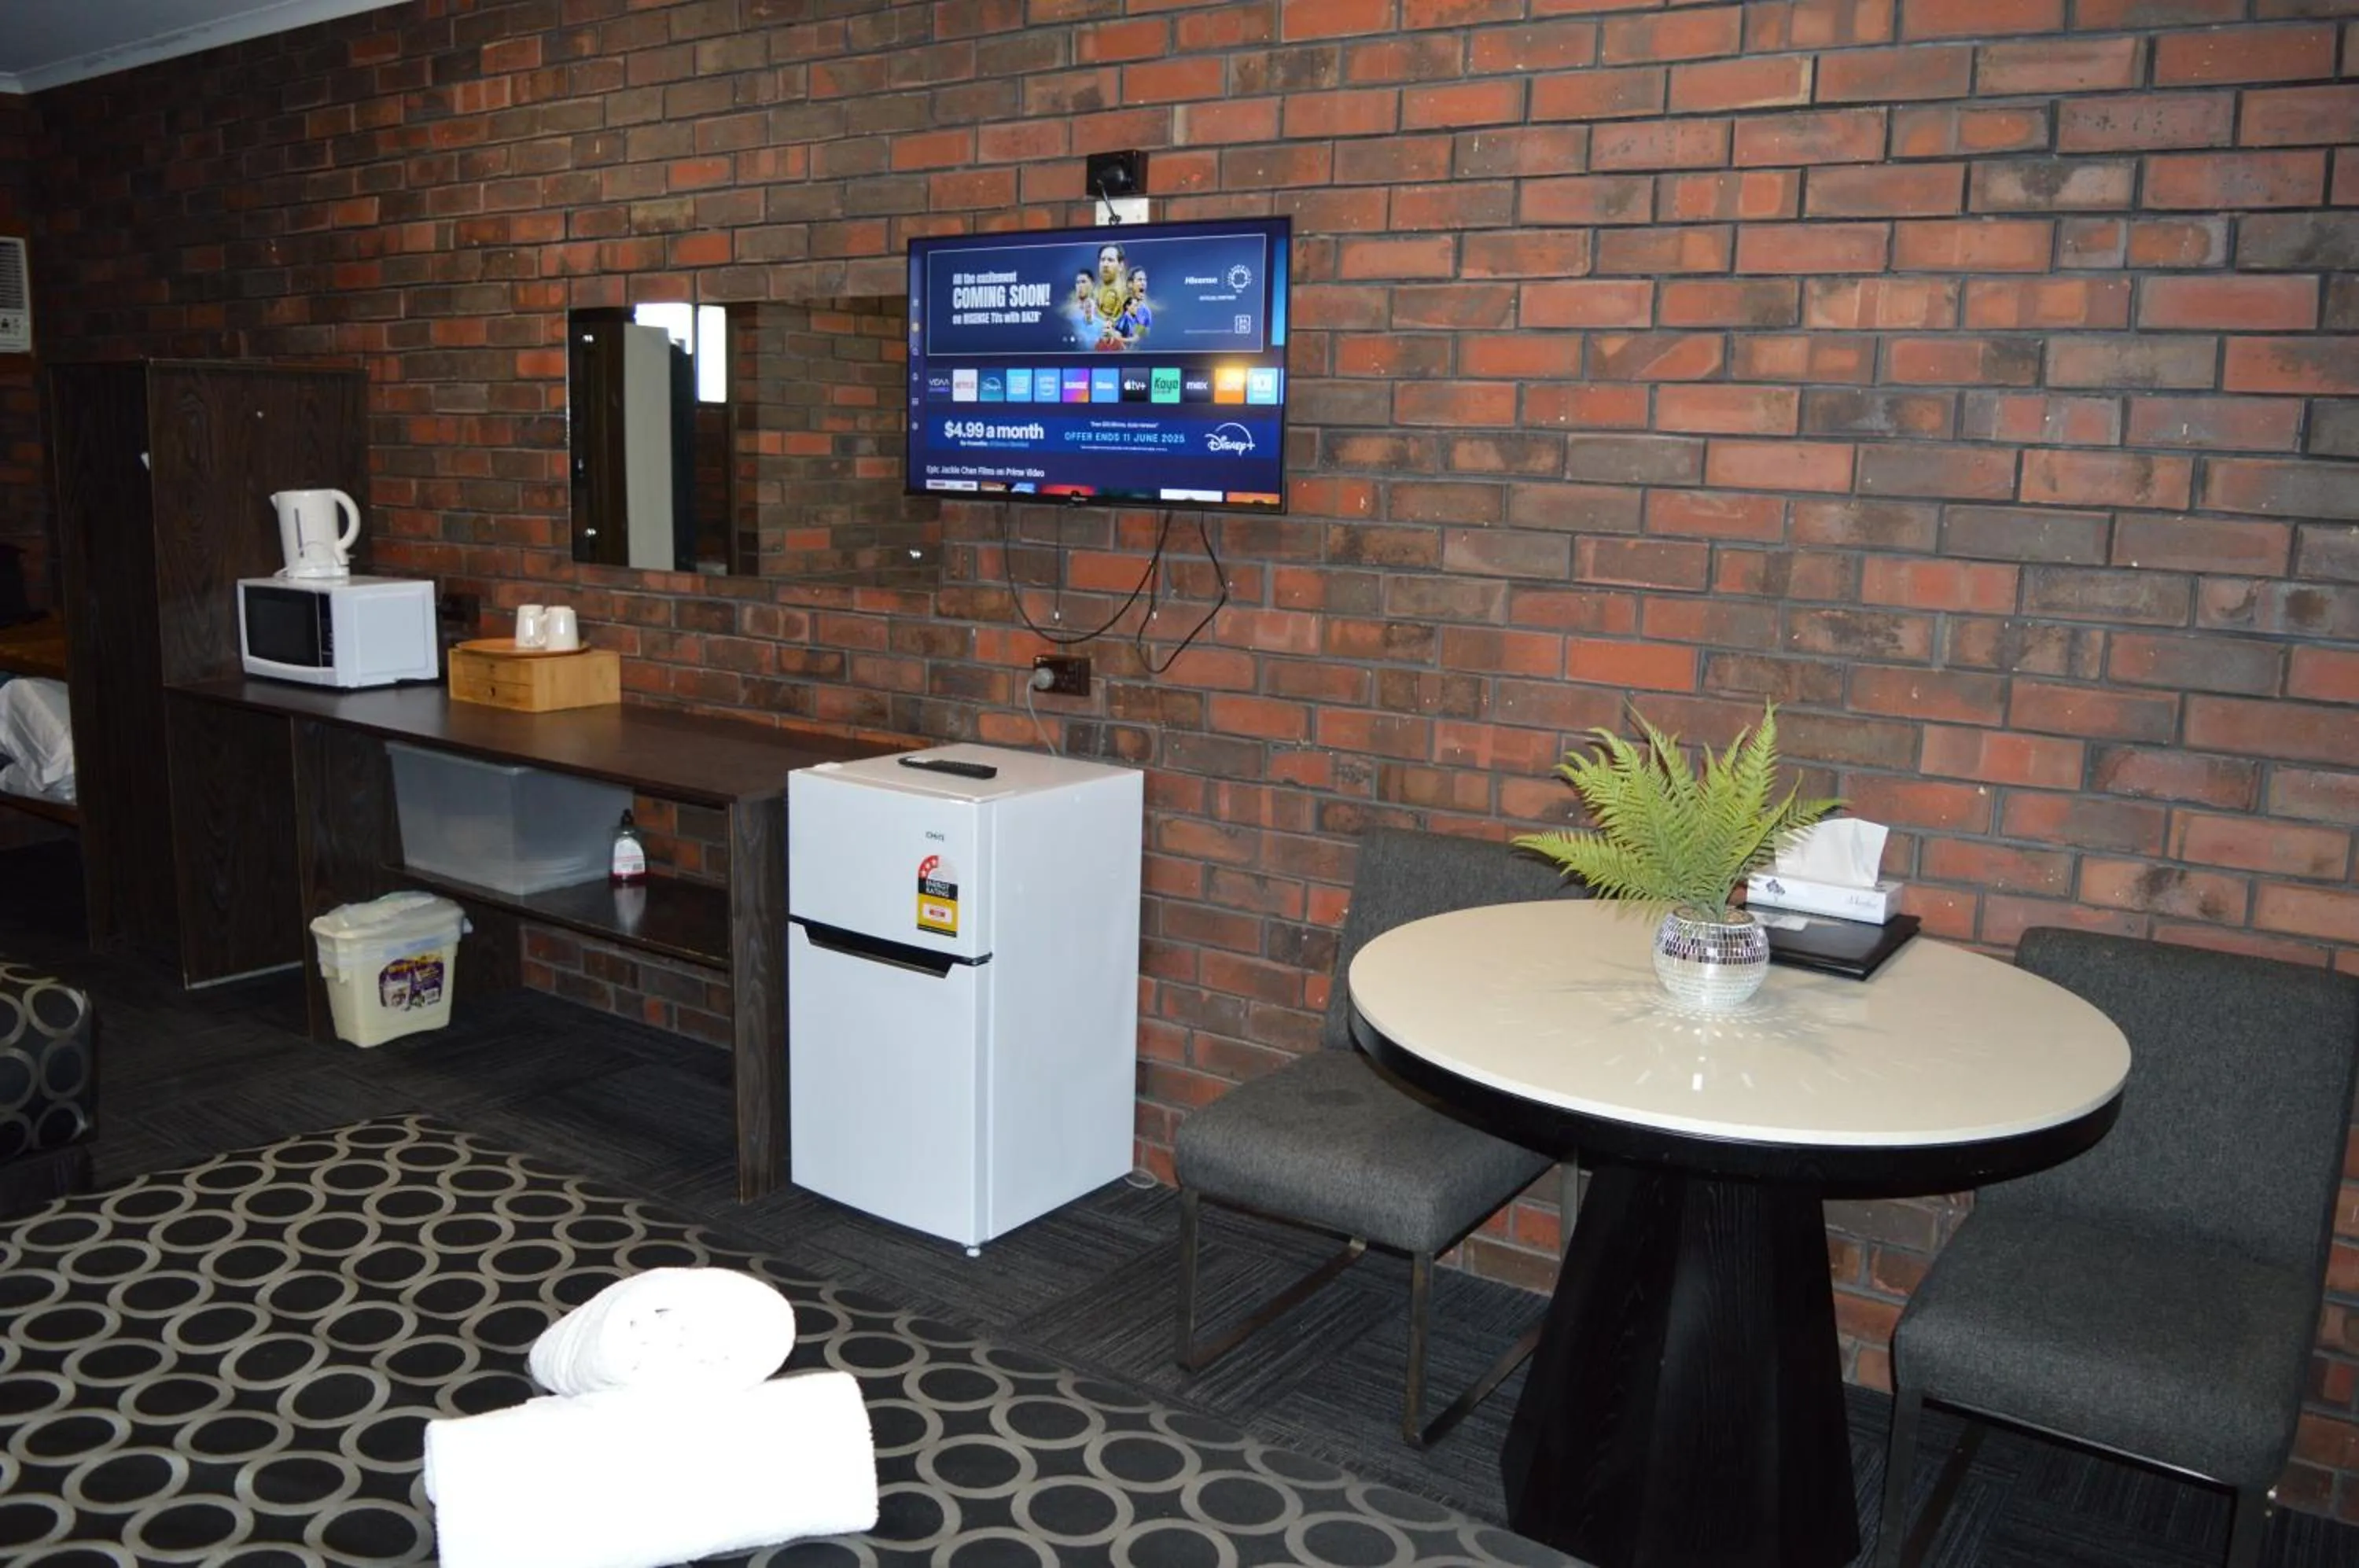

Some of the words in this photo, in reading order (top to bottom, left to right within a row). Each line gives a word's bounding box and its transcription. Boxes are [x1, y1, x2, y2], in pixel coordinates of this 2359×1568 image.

[964, 273, 975, 284] the
[953, 285, 1006, 309] COMING
[1009, 283, 1051, 307] SOON!
[1154, 377, 1179, 389] Kayo
[1186, 381, 1209, 390] max
[944, 420, 984, 439] $4.99
[986, 425, 995, 439] a
[996, 422, 1045, 440] month
[1064, 432, 1092, 441] OFFER
[1095, 432, 1120, 442] ENDS
[1123, 433, 1131, 442] 11
[1133, 433, 1158, 443] JUNE
[1161, 433, 1186, 444] 2025
[941, 466, 960, 474] Jackie
[961, 466, 977, 475] Chan
[1007, 468, 1025, 477] Prime
[1026, 468, 1045, 477] Video
